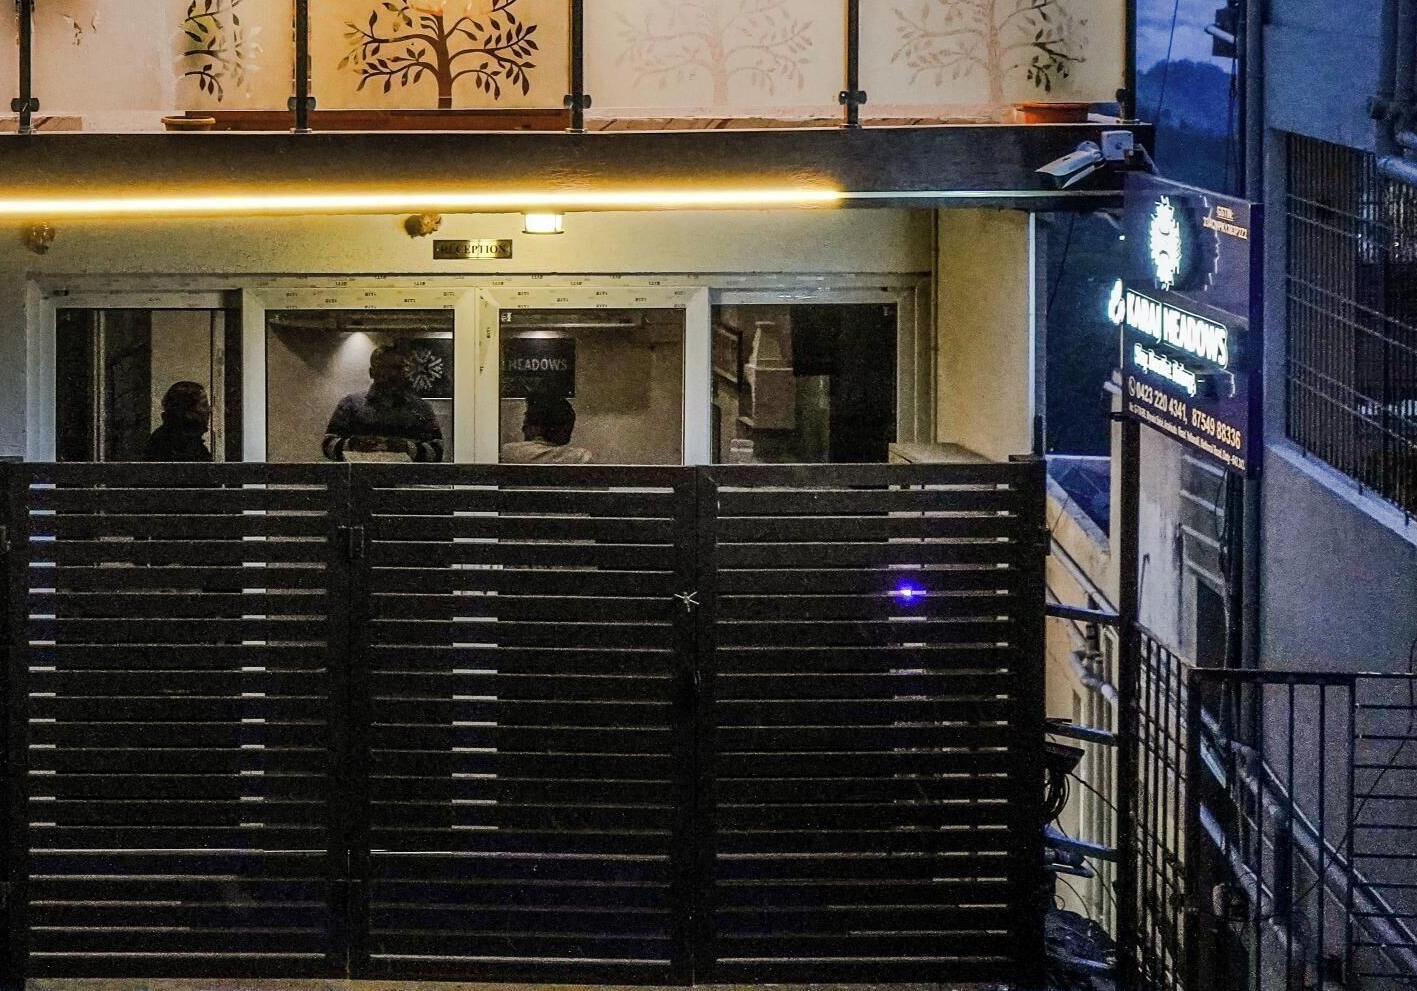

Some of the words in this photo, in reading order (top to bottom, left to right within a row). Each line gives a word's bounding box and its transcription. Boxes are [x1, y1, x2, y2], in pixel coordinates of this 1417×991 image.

[440, 244, 506, 254] RECEPTION
[1163, 305, 1227, 367] MEADOWS
[1136, 382, 1153, 405] 0423
[1154, 390, 1168, 412] 220
[1192, 408, 1215, 436] 87549
[1216, 421, 1241, 450] 88336
